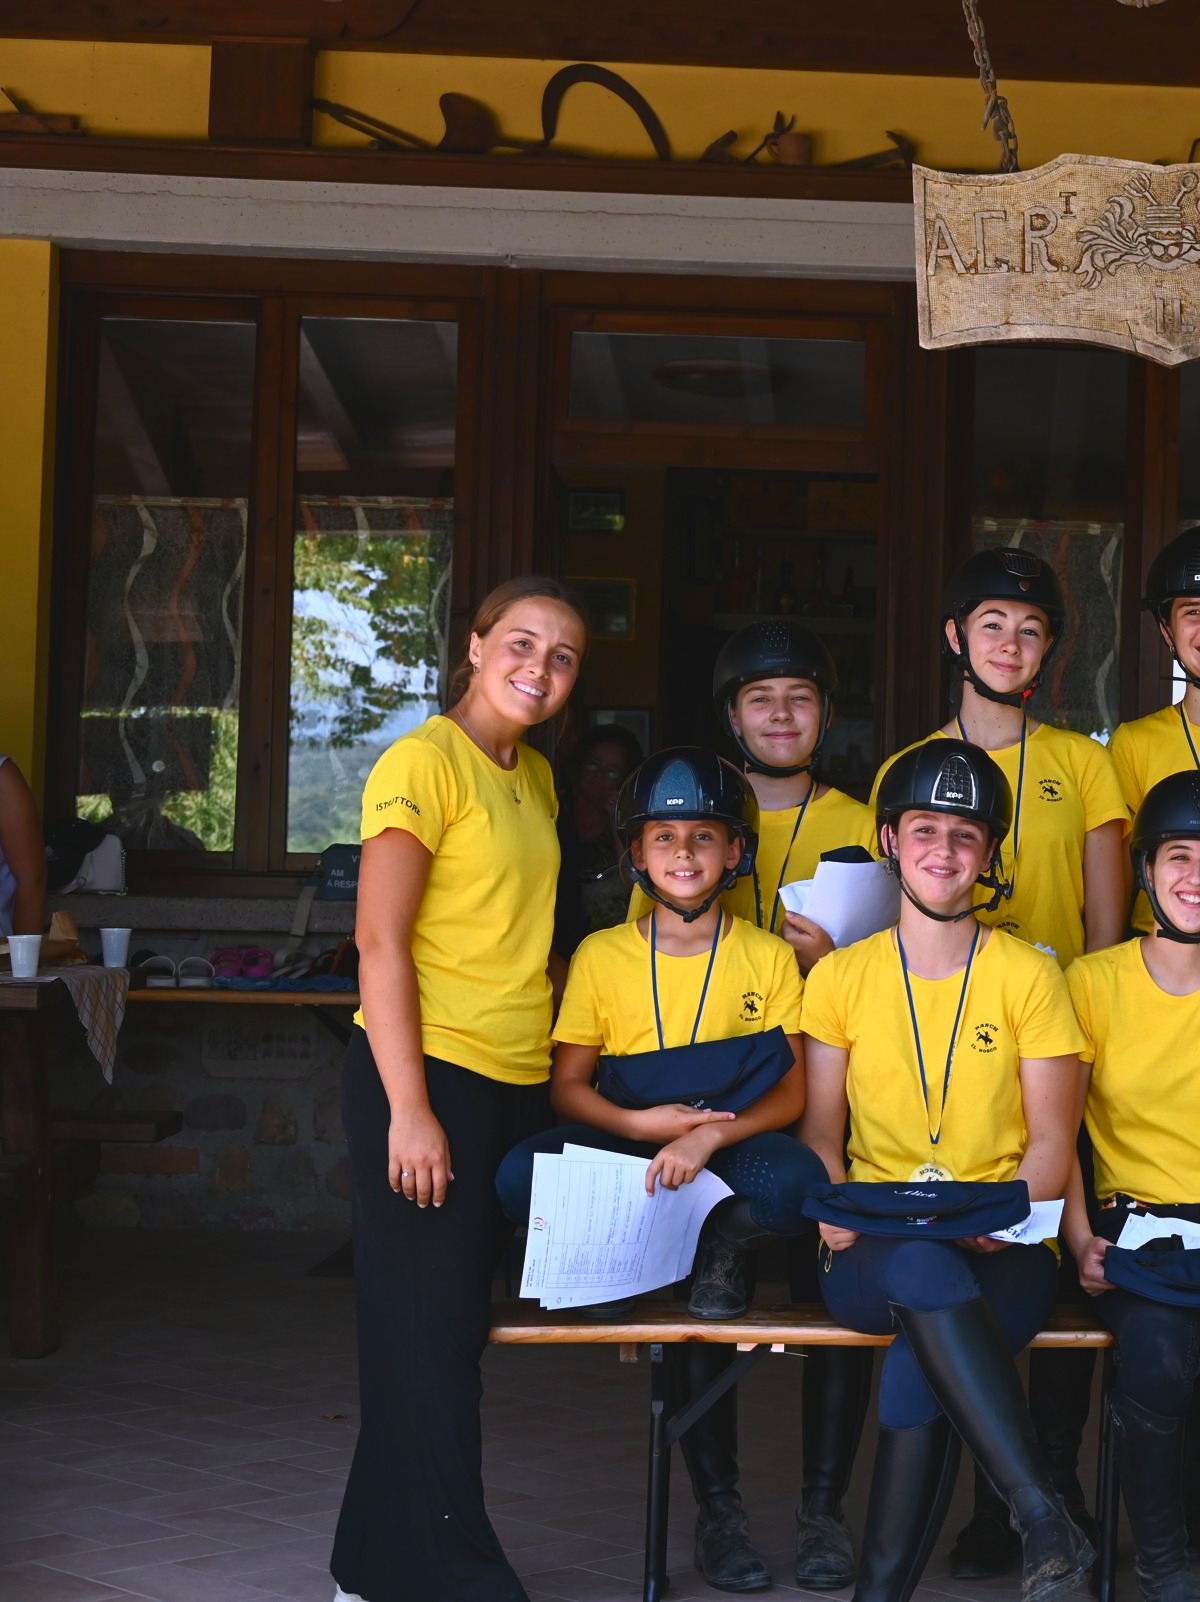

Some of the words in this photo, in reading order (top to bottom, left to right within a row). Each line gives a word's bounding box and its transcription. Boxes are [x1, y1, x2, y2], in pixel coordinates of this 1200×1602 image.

[334, 880, 358, 889] RESP
[741, 991, 764, 1002] RANCH
[974, 1023, 999, 1033] RANCH
